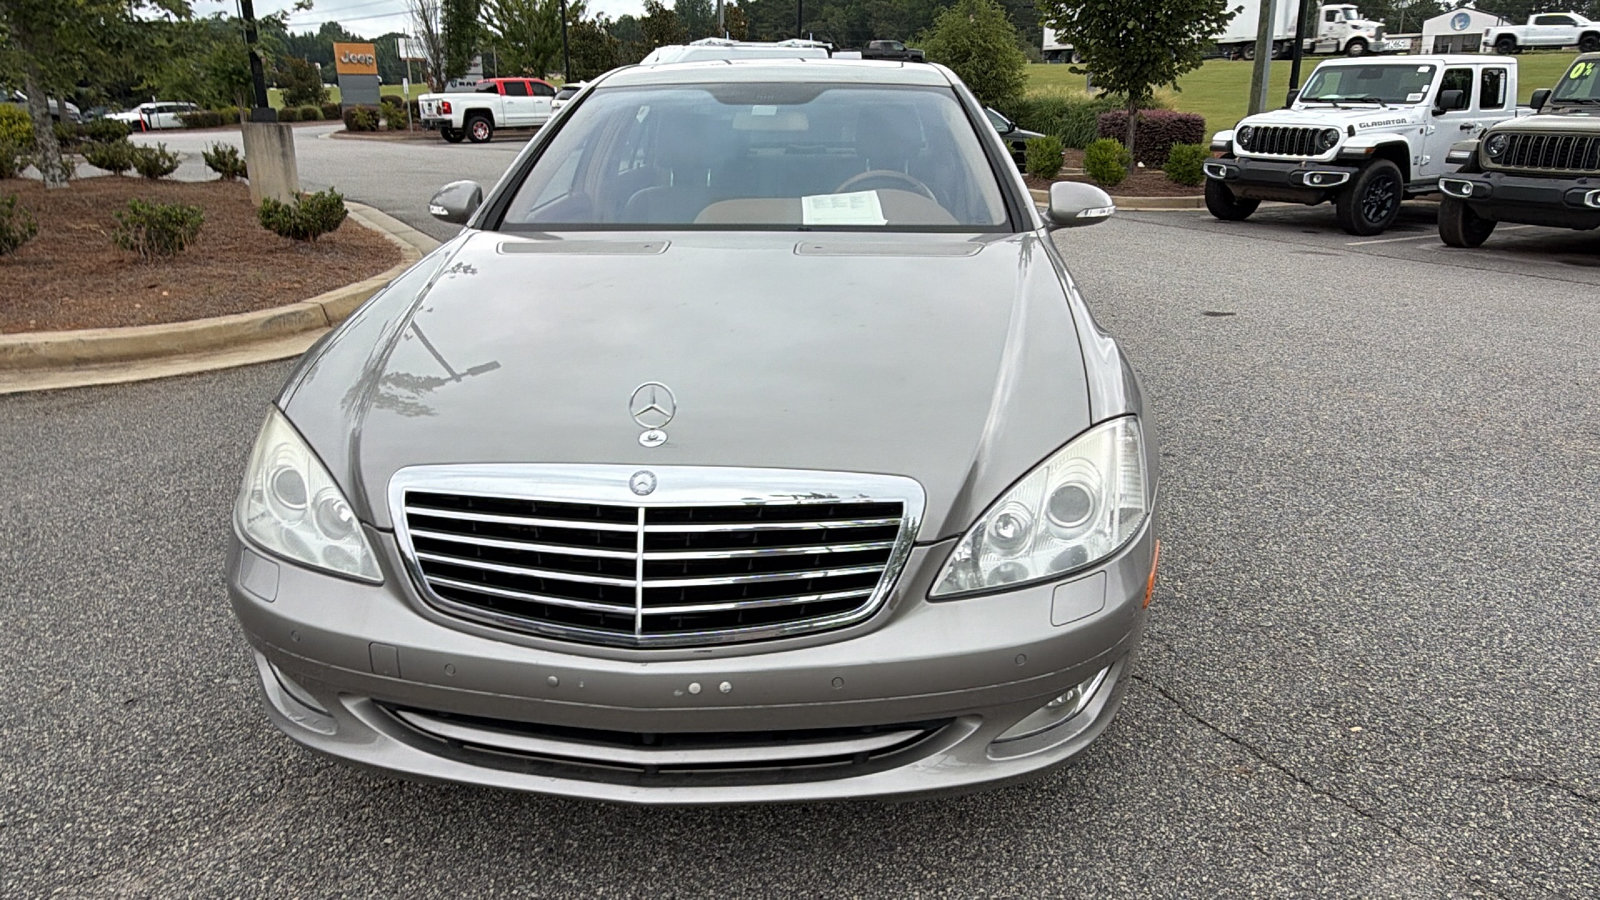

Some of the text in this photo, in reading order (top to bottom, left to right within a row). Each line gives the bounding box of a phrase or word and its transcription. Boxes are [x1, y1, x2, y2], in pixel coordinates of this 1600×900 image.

[341, 51, 374, 66] Jeep
[1570, 62, 1595, 79] 0%
[1359, 118, 1407, 129] GLADIATOR
